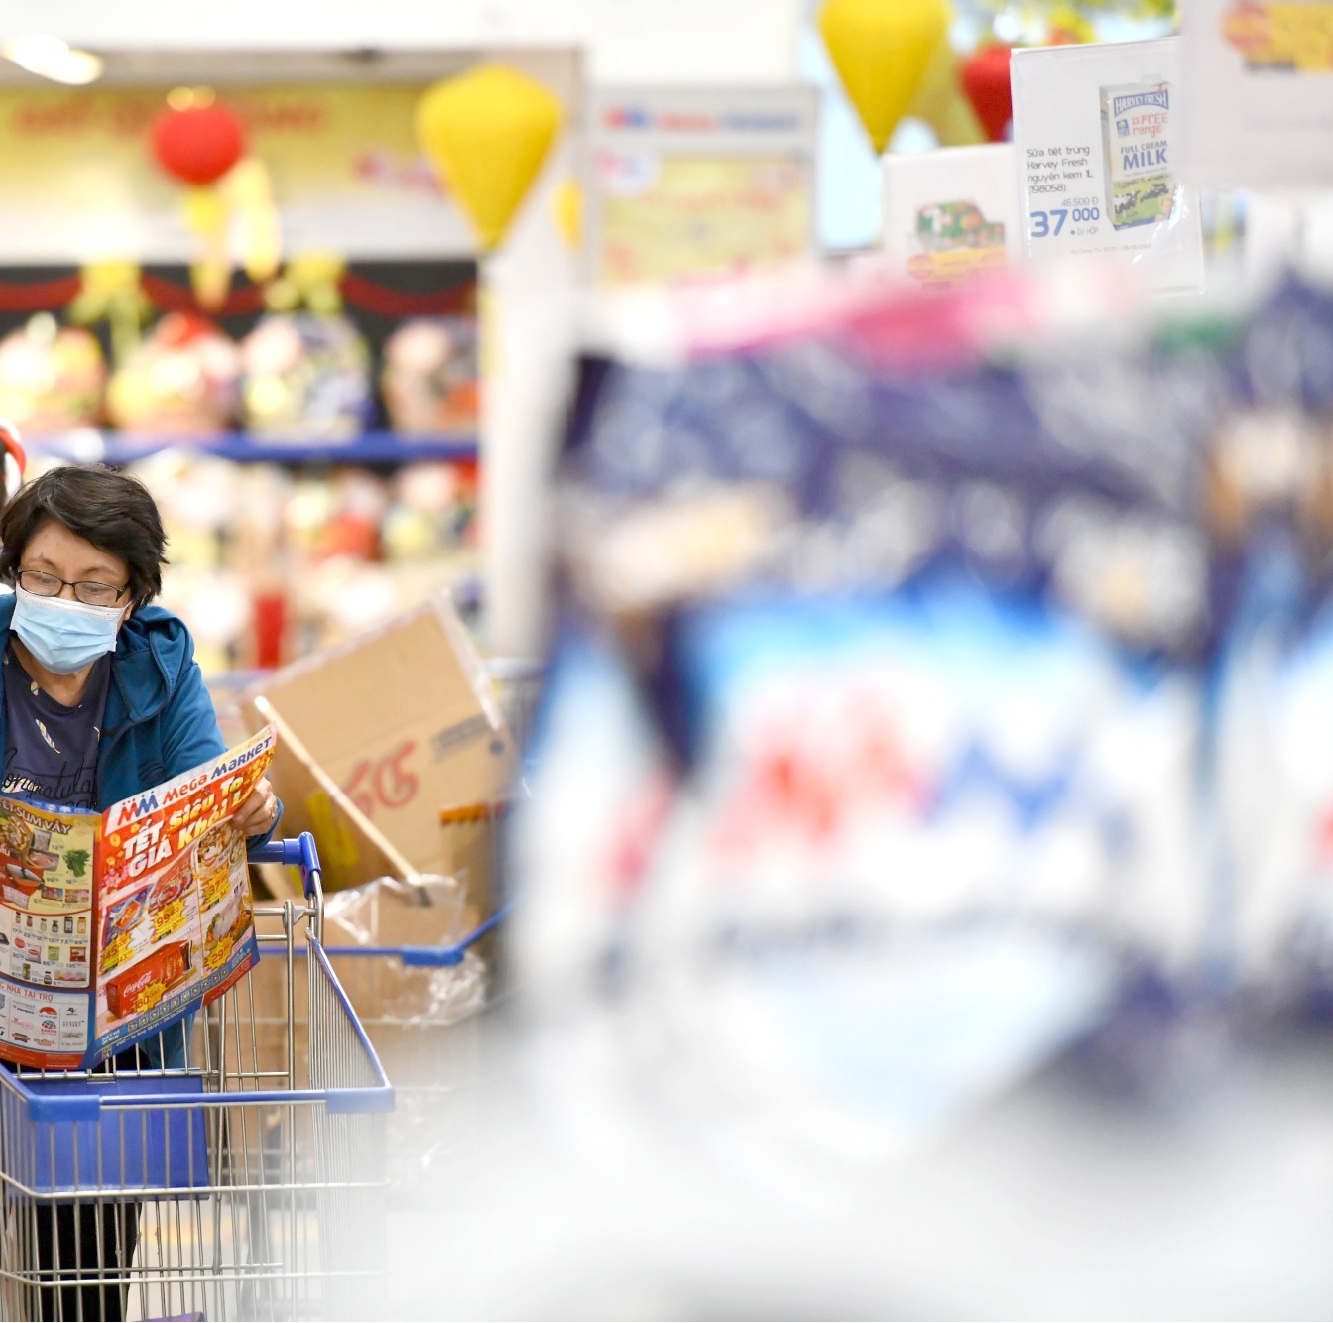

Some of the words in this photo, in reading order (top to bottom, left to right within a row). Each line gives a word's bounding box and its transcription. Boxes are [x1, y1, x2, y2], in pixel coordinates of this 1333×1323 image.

[1115, 96, 1144, 114] HARVEY
[1145, 91, 1167, 107] FRESH
[1120, 145, 1139, 154] FULL
[1141, 140, 1167, 150] CREAM
[1027, 161, 1058, 170] Harvey
[1061, 157, 1088, 167] Fresh
[1123, 148, 1167, 170] MILK
[1063, 171, 1082, 179] kem
[16, 806, 42, 827] SUM
[128, 834, 173, 878] GIÁ
